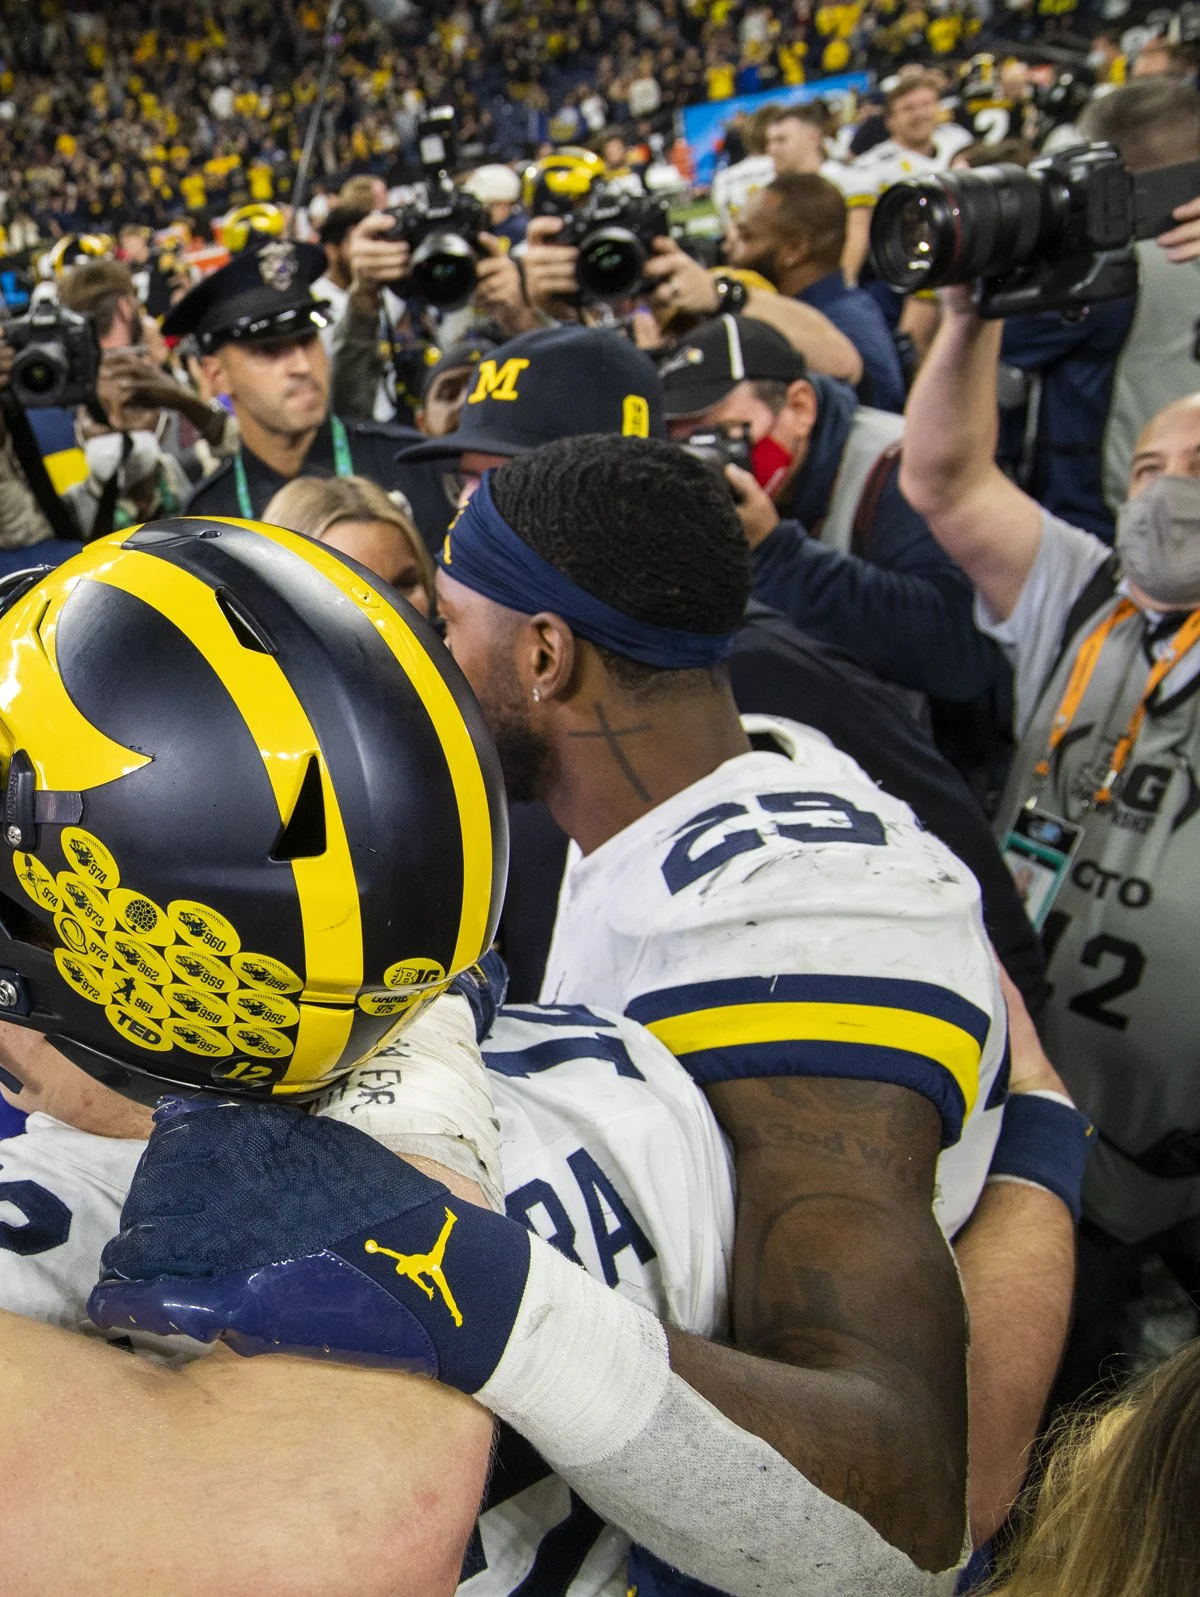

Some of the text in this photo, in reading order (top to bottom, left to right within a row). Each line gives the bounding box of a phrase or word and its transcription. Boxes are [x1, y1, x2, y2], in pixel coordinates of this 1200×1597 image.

[467, 358, 530, 404] M
[87, 863, 108, 885] 974
[41, 886, 59, 908] 974
[84, 905, 105, 927] 973
[88, 941, 109, 962] 972
[202, 931, 227, 953] 960
[137, 961, 160, 982] 962
[200, 972, 225, 990] 959
[80, 980, 101, 1001] 972
[264, 978, 290, 992] 956
[134, 997, 154, 1014] 961
[197, 1007, 222, 1024] 958
[116, 1009, 162, 1046] TED
[261, 1010, 287, 1025] 955
[196, 1041, 221, 1055] 957
[257, 1041, 281, 1056] 954
[222, 1061, 273, 1081] 12
